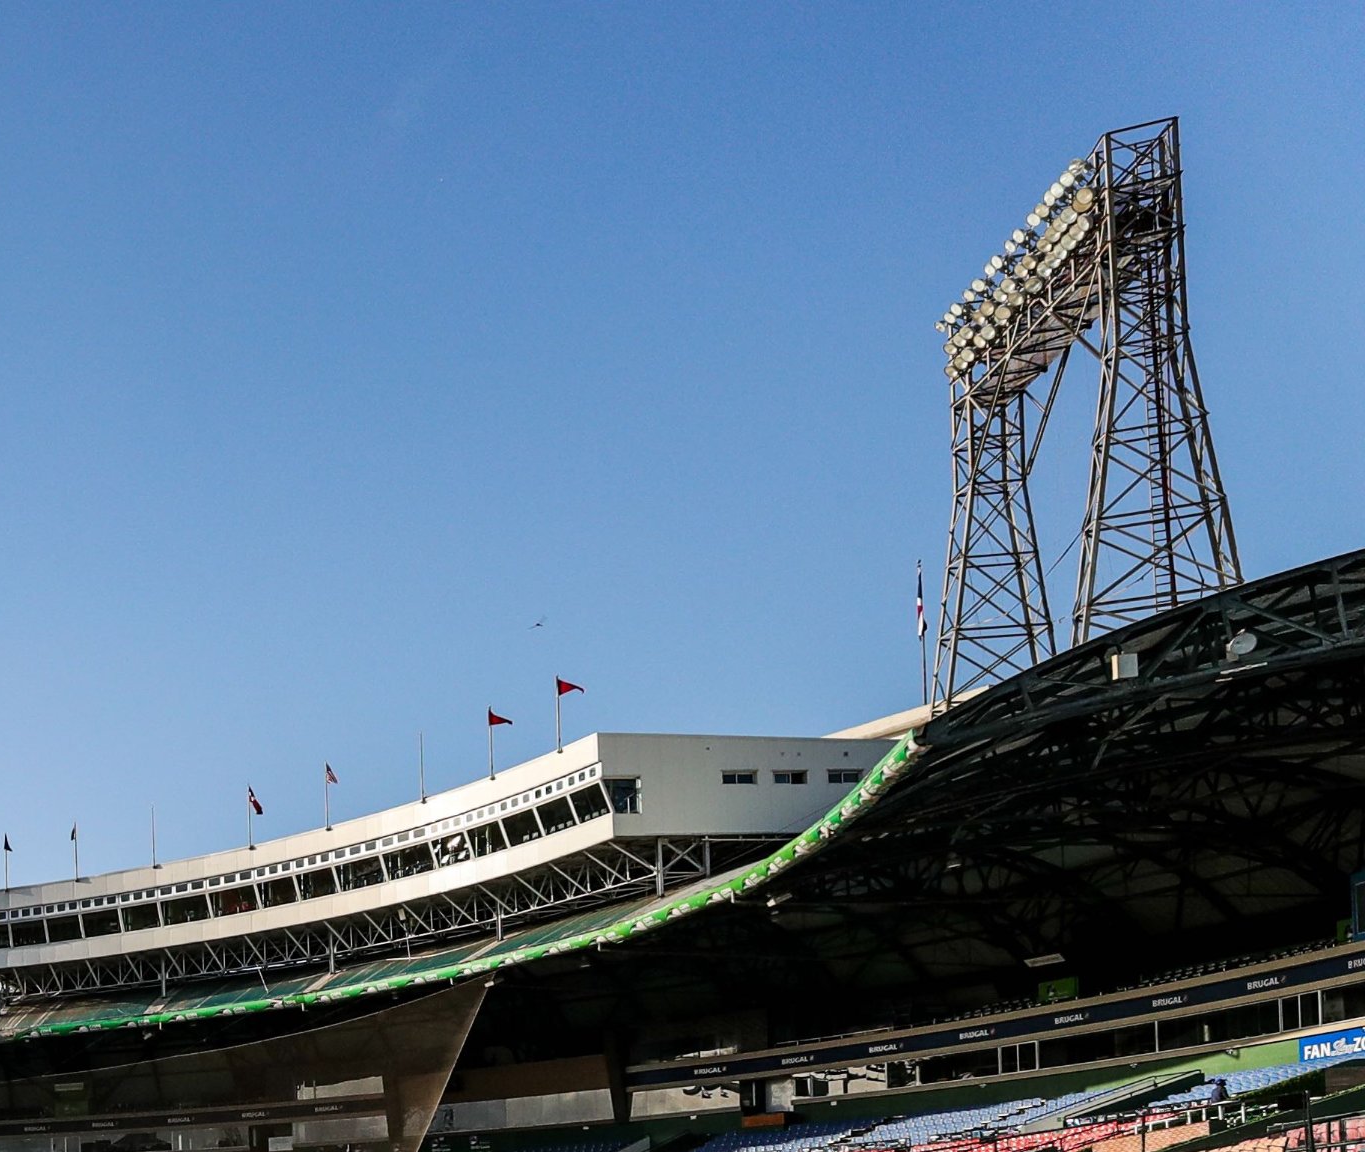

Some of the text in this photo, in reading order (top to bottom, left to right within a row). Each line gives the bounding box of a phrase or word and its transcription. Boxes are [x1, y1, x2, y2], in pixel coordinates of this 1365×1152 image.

[1246, 977, 1280, 990] BRUGAL
[1152, 996, 1183, 1007] BRUGAL
[1054, 1014, 1084, 1024] BRUGAL
[868, 1044, 898, 1053] BRUGAL
[1304, 1042, 1331, 1060] FAN
[781, 1056, 809, 1065] BRUGAL
